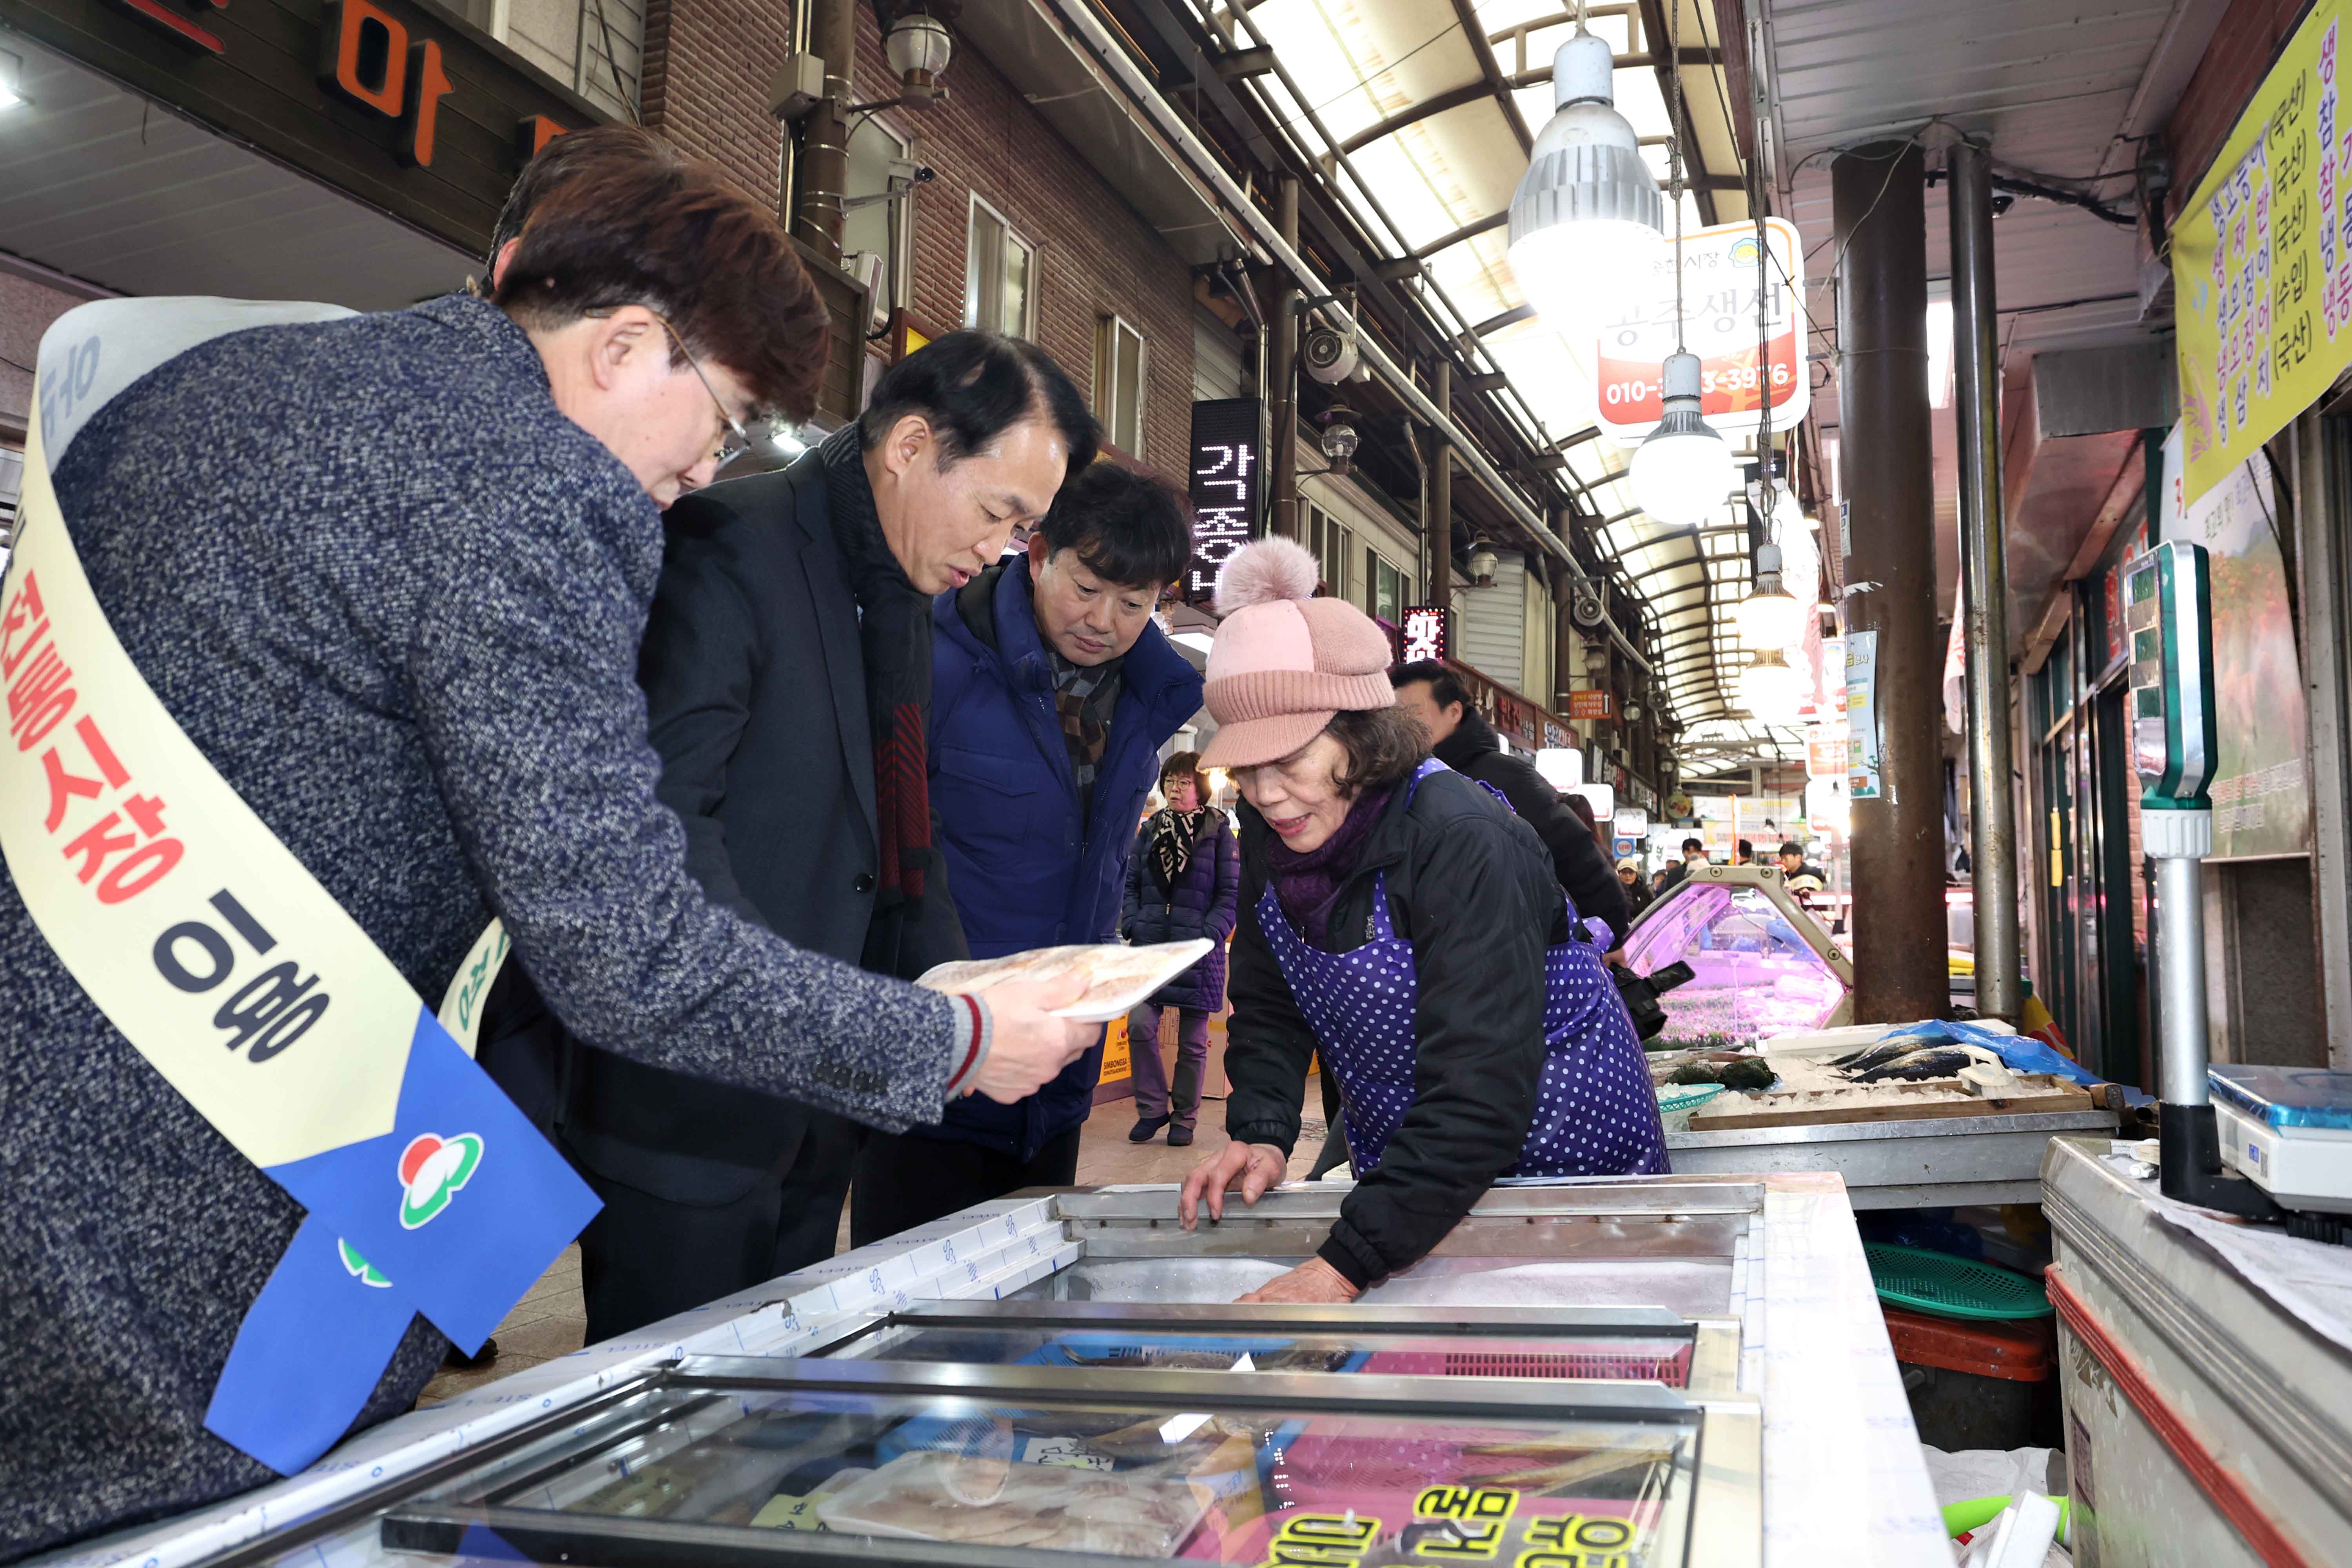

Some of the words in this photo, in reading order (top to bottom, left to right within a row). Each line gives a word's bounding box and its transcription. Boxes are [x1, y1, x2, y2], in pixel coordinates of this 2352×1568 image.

[2269, 69, 2306, 150] (국산)
[2274, 129, 2307, 207] (국산)
[2217, 292, 2269, 391] 냉오징어
[2274, 249, 2308, 322] (수입)
[2218, 238, 2269, 340] 생오징어
[2274, 189, 2307, 265] (국산)
[1606, 363, 1789, 405] 010-3-396
[2217, 350, 2269, 443] 생삼치
[2274, 310, 2312, 381] (국산)
[1, 568, 185, 905] 전통시장
[152, 887, 330, 1063] 이용
